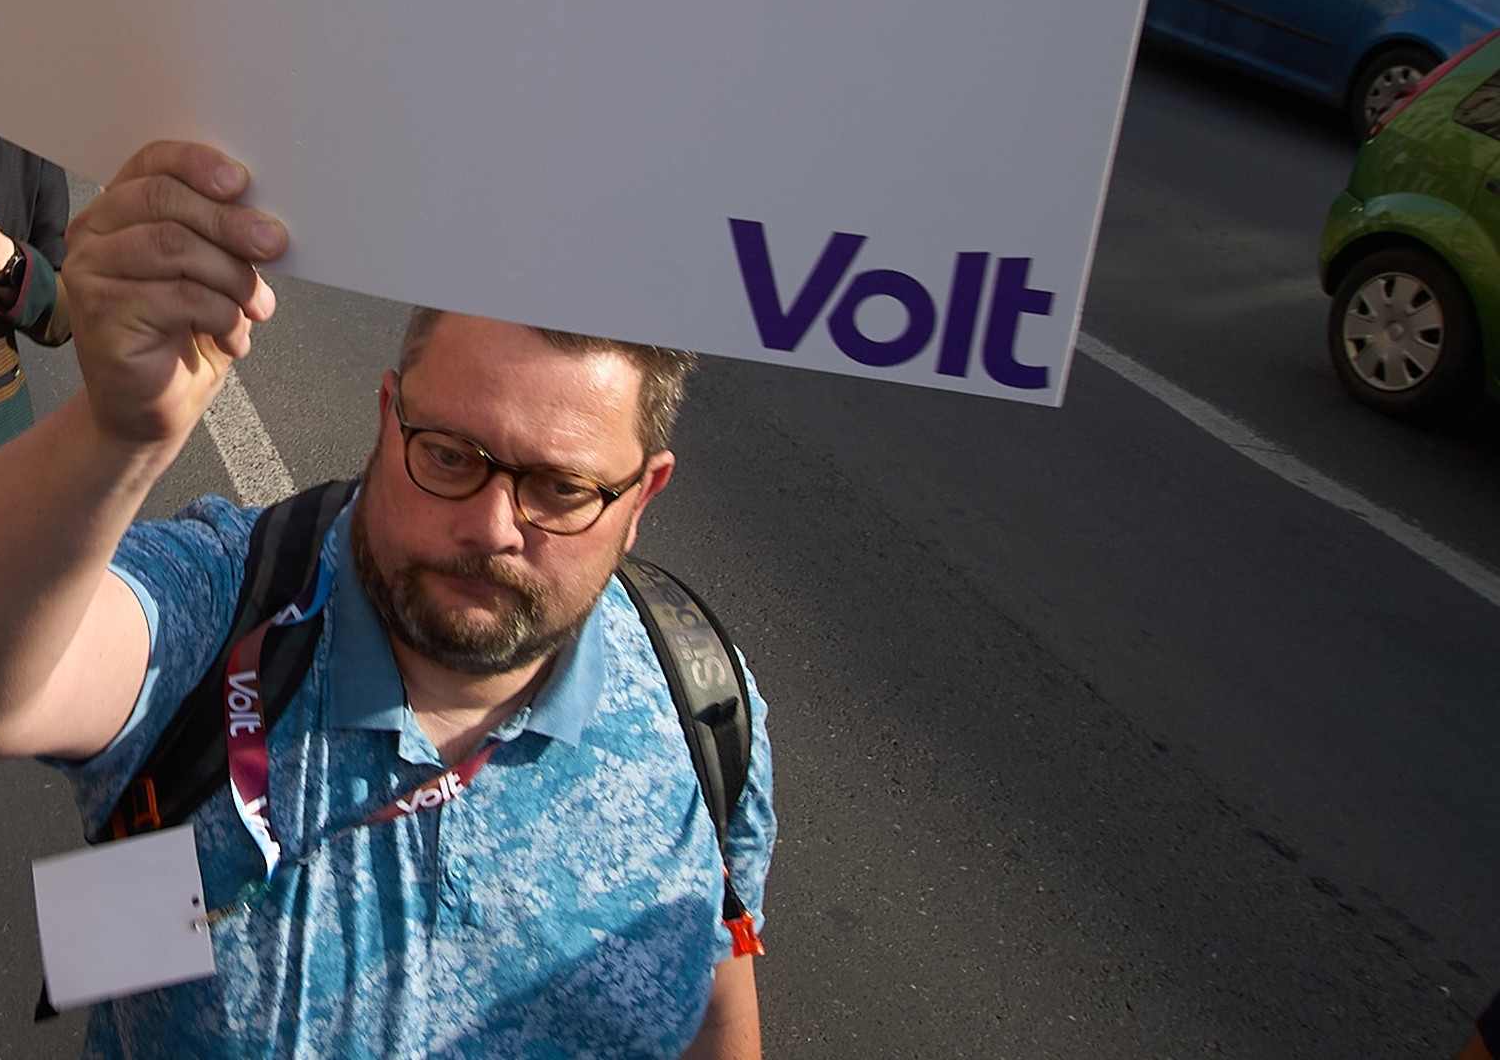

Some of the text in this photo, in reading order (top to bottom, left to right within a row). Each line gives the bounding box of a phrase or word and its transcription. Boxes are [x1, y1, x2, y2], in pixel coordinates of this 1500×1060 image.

[727, 217, 1056, 390] Volt
[227, 669, 263, 738] Volt
[395, 770, 465, 813] Volt
